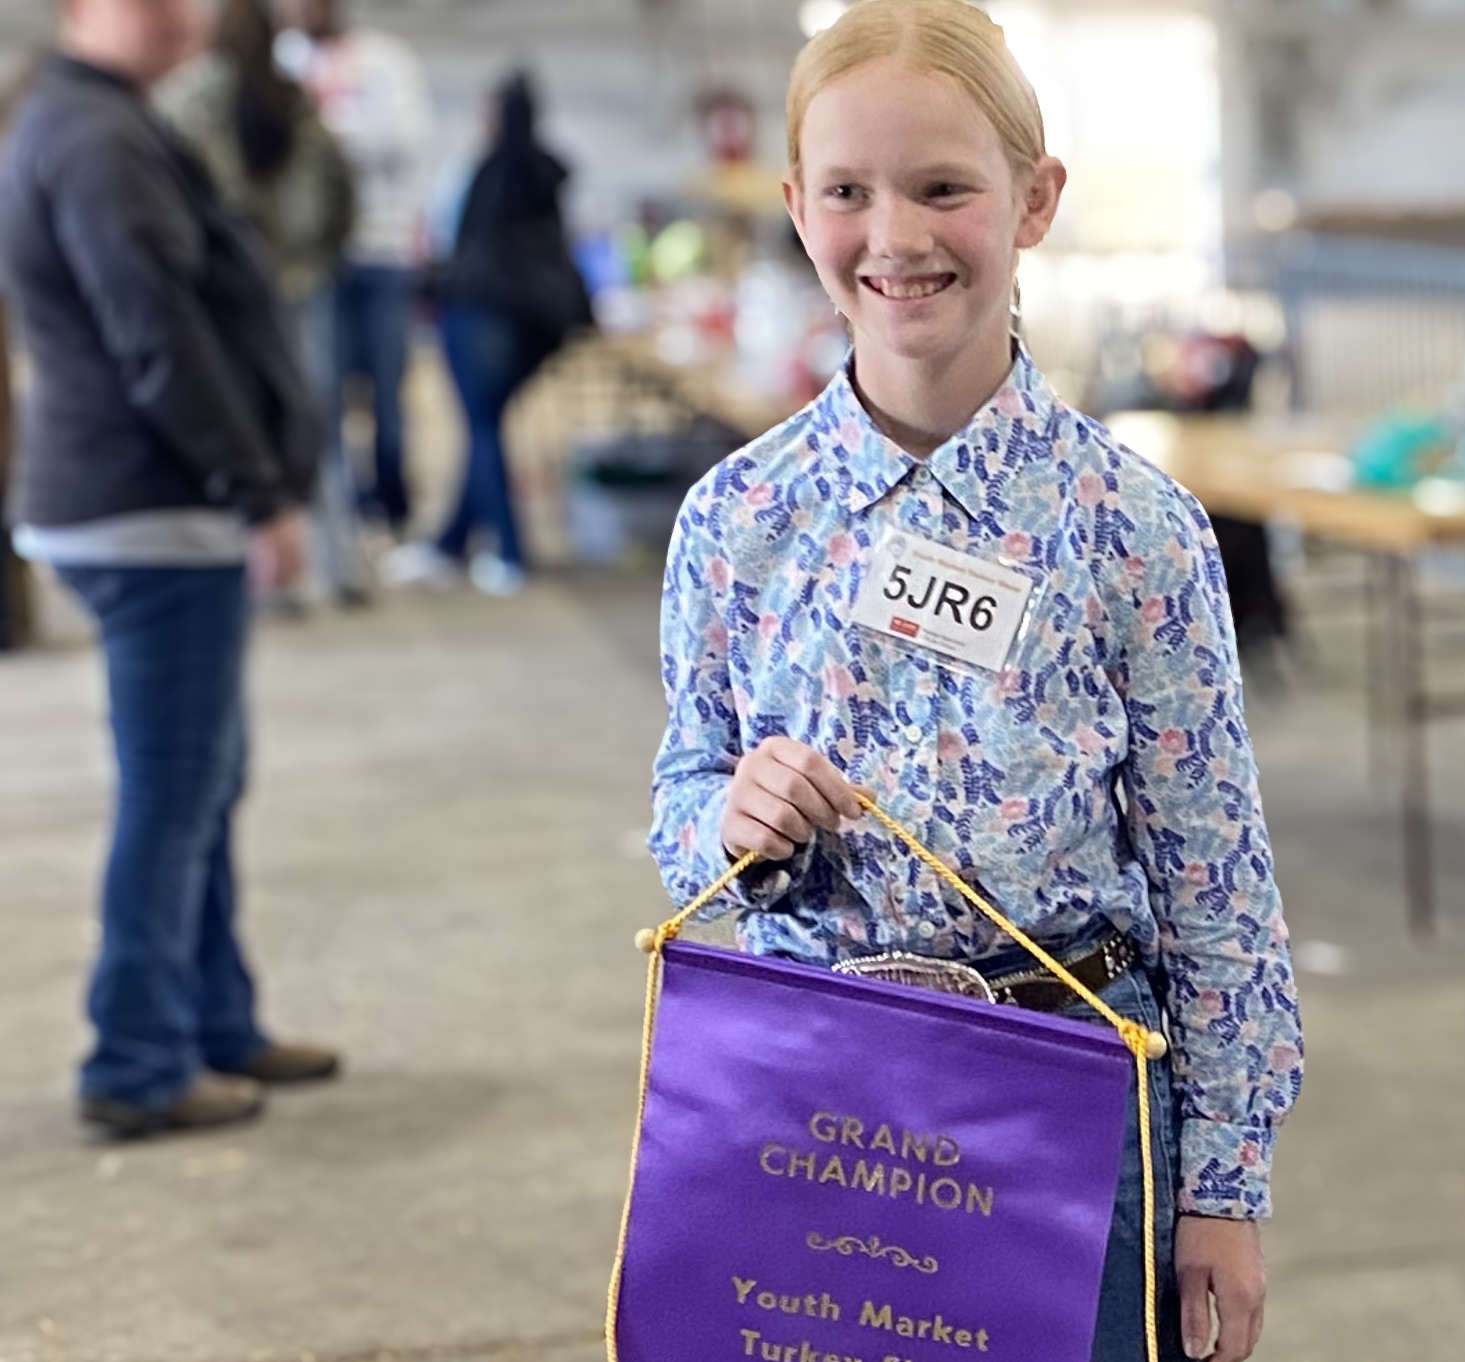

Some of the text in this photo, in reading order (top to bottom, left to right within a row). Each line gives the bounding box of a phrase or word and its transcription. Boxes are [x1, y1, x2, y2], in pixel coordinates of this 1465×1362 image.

[882, 564, 998, 632] 5JR6
[809, 1111, 960, 1167] GRAND
[759, 1143, 995, 1217] CHAMPION
[731, 1276, 989, 1352] Youth Market
